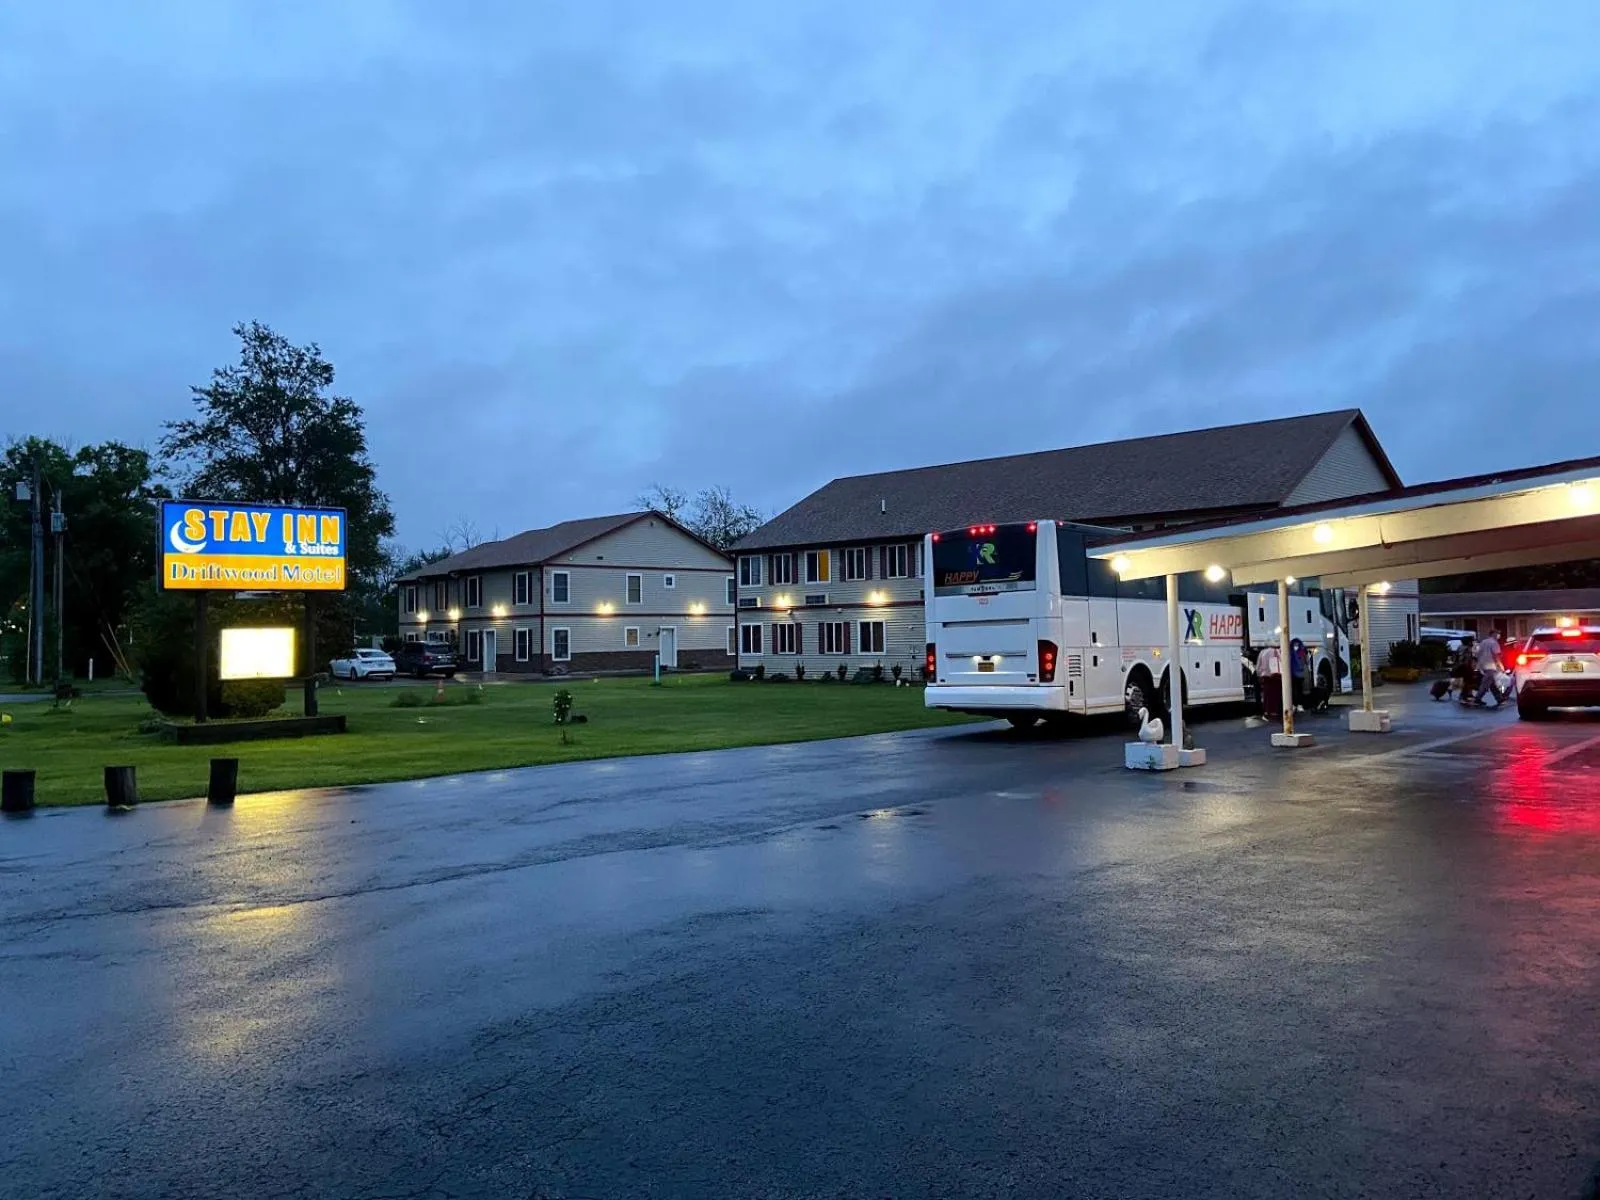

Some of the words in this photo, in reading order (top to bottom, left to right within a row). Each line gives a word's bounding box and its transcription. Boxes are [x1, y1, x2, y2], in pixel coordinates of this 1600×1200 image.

[184, 509, 271, 542] STAY
[283, 513, 340, 544] INN
[285, 543, 296, 555] &
[300, 543, 339, 555] Suites
[171, 562, 277, 582] Driftwood
[282, 564, 340, 583] Motel
[944, 570, 979, 584] HAPPY
